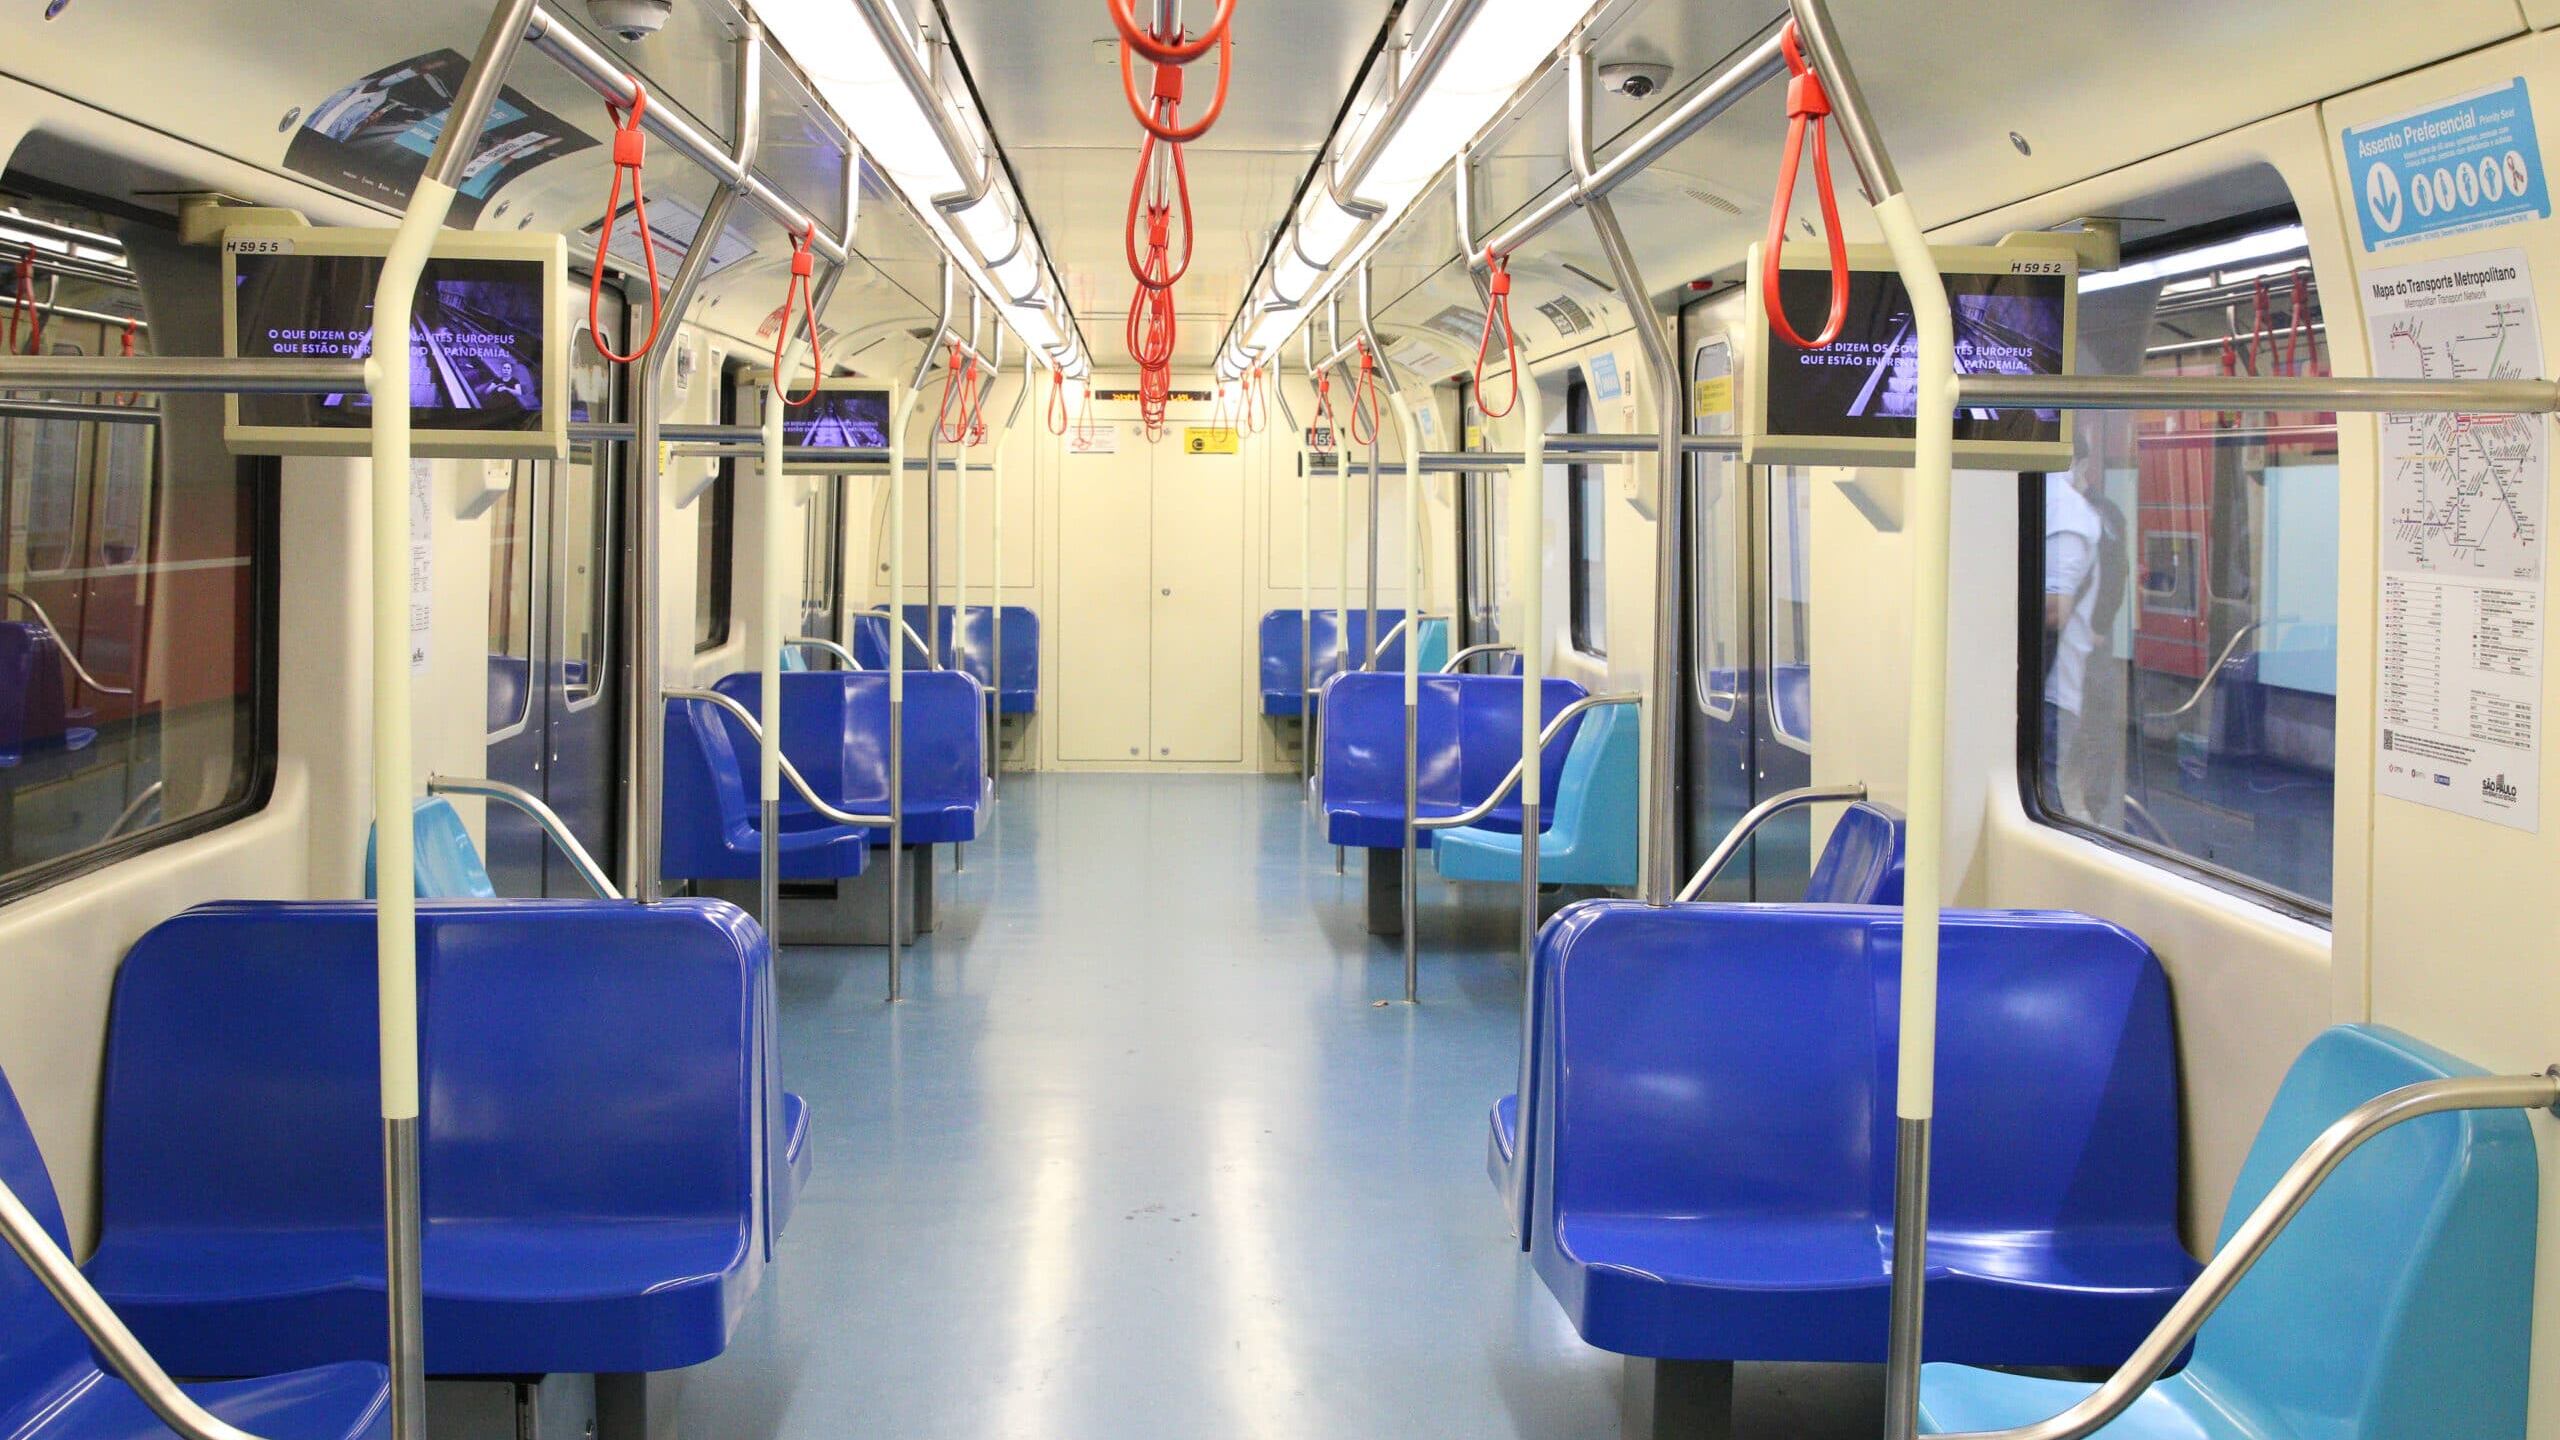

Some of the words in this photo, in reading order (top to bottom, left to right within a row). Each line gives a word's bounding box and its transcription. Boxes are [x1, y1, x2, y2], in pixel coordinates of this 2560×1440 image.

[2358, 134, 2402, 159] Assento
[2404, 108, 2476, 145] Preferencial
[2372, 283, 2396, 300] Mapa
[2396, 281, 2407, 295] do
[2407, 274, 2453, 293] Transporte
[2454, 266, 2516, 287] Metropolitano
[268, 329, 279, 339] O
[281, 329, 306, 340] QUE
[309, 330, 345, 340] DIZEM
[348, 331, 364, 341] OS
[456, 333, 515, 344] EUROPEUS
[273, 343, 299, 353] QUE
[302, 341, 339, 354] ESTÃO
[1835, 342, 1869, 352] DIZEM
[1872, 343, 1889, 353] OS
[1976, 346, 2033, 357] EUROPEUS
[1800, 355, 1825, 365] QUE
[1828, 353, 1863, 366] ESTÃO
[2482, 777, 2495, 791] SÃO
[2496, 783, 2517, 797] PAULO
